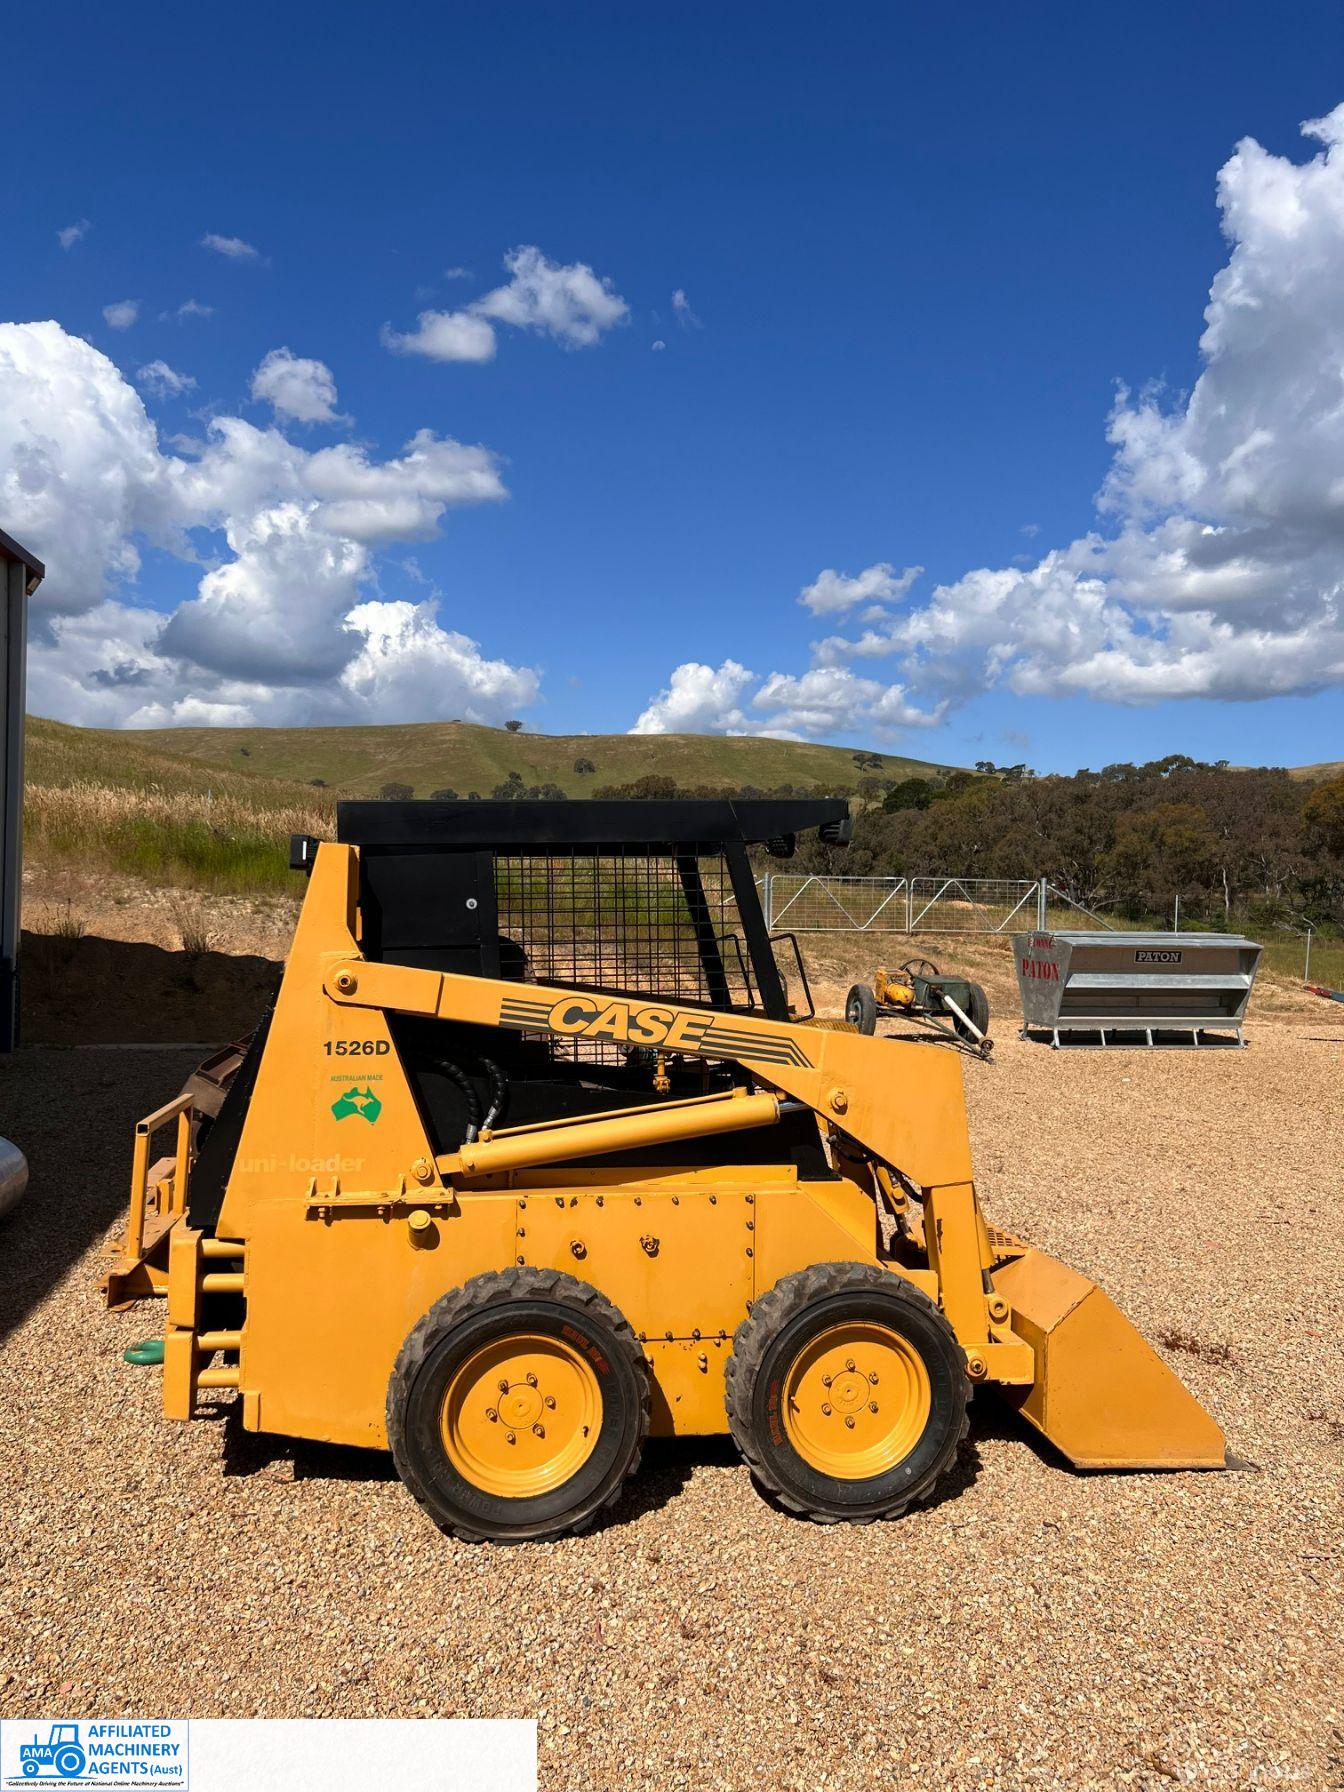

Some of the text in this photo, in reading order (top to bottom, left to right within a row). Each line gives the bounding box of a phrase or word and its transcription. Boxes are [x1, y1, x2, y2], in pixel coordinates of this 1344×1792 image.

[1137, 951, 1180, 962] PATON
[1022, 958, 1059, 981] PATON
[548, 997, 714, 1050] CASE
[323, 1040, 390, 1056] 1526D
[238, 1153, 365, 1172] uni-loader
